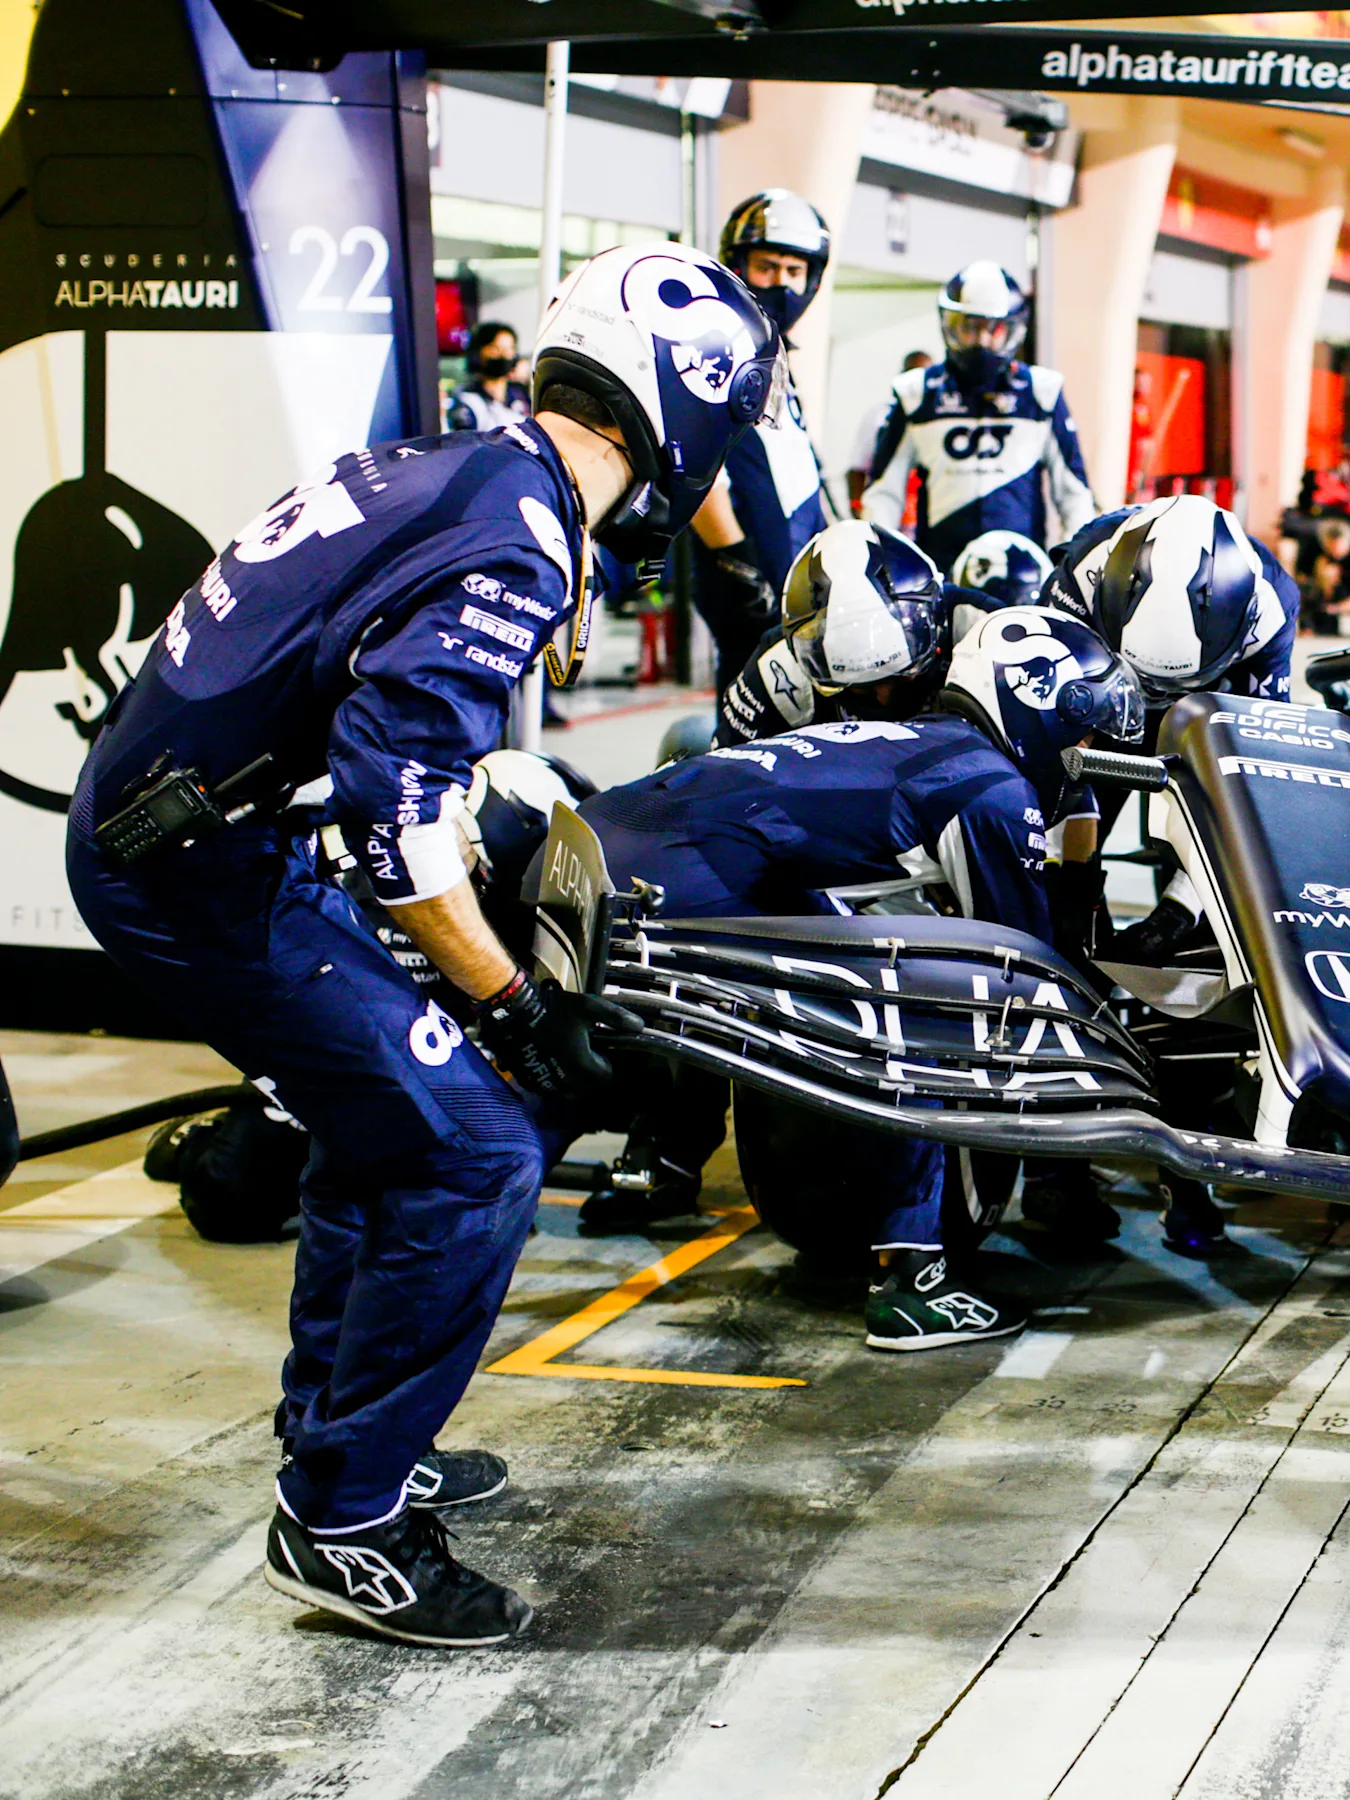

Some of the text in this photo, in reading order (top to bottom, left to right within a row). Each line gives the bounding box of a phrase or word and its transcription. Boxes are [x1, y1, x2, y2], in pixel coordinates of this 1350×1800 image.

[55, 253, 238, 269] SCUDERIA
[288, 225, 393, 314] 22
[54, 279, 239, 309] ALPHATAURI
[502, 591, 558, 622] myWorld
[459, 603, 535, 653] PIRELLI
[576, 619, 591, 649] GRID
[1239, 728, 1335, 750] CASIO
